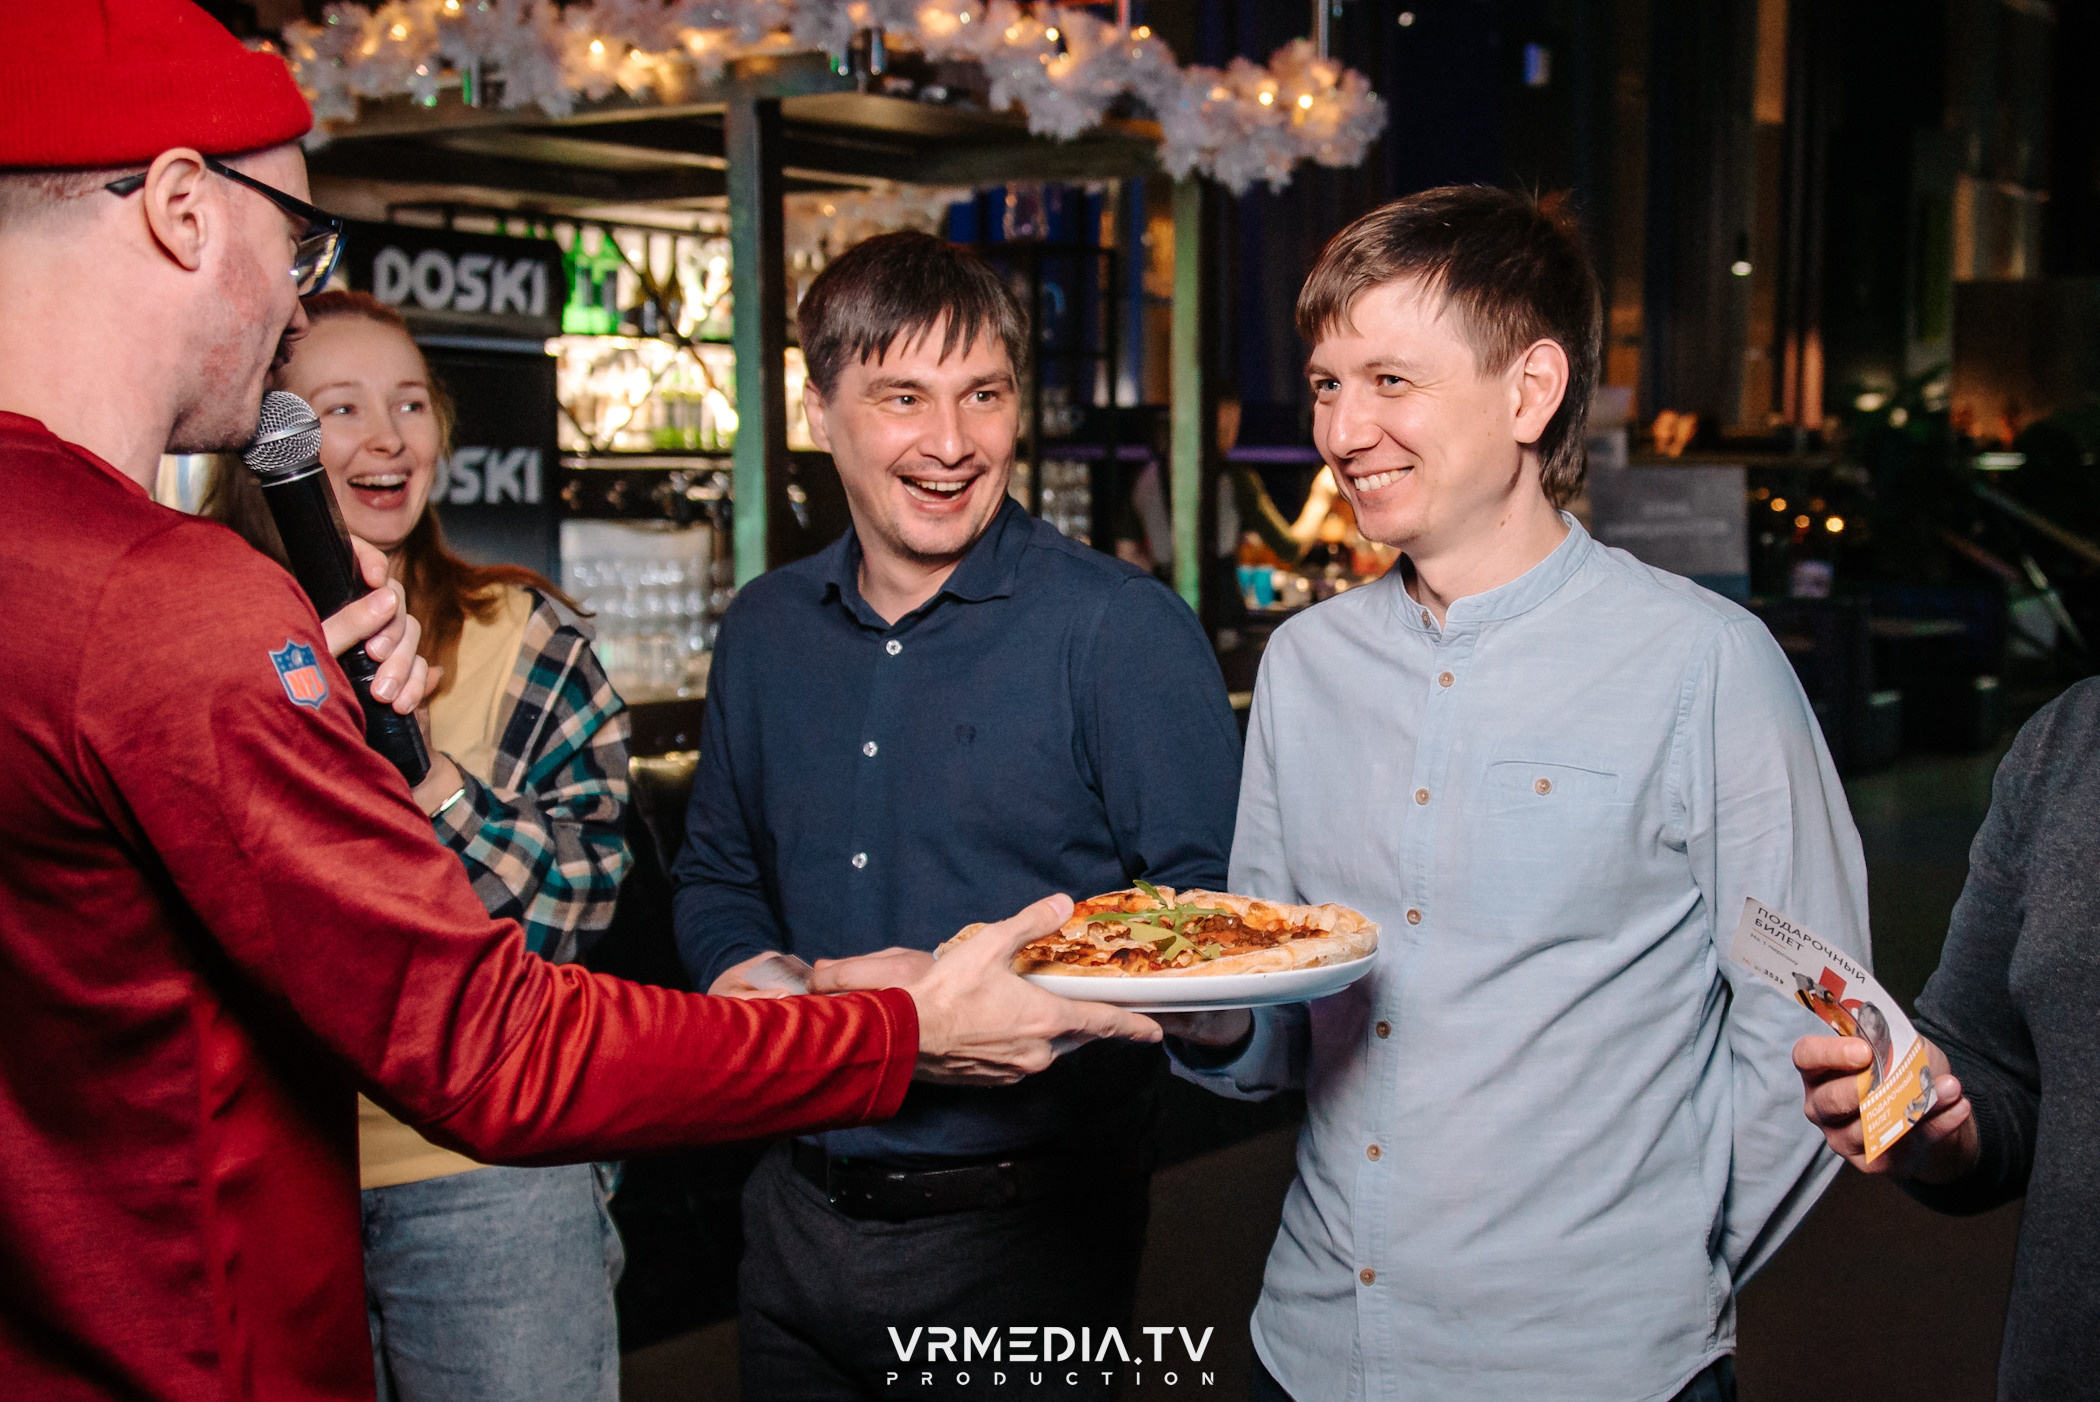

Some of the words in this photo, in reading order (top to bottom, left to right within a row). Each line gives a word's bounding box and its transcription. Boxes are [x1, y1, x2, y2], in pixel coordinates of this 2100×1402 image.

[373, 246, 549, 318] DOSKI
[430, 446, 543, 504] SKI
[284, 666, 326, 701] NFL
[1754, 918, 1805, 951] БИЛЕТ
[1758, 907, 1866, 985] ПОДАРОЧНЫЙ
[1866, 1070, 1914, 1122] ПОДАРОЧНЫЙ
[1867, 1108, 1892, 1133] БИЛЕТ
